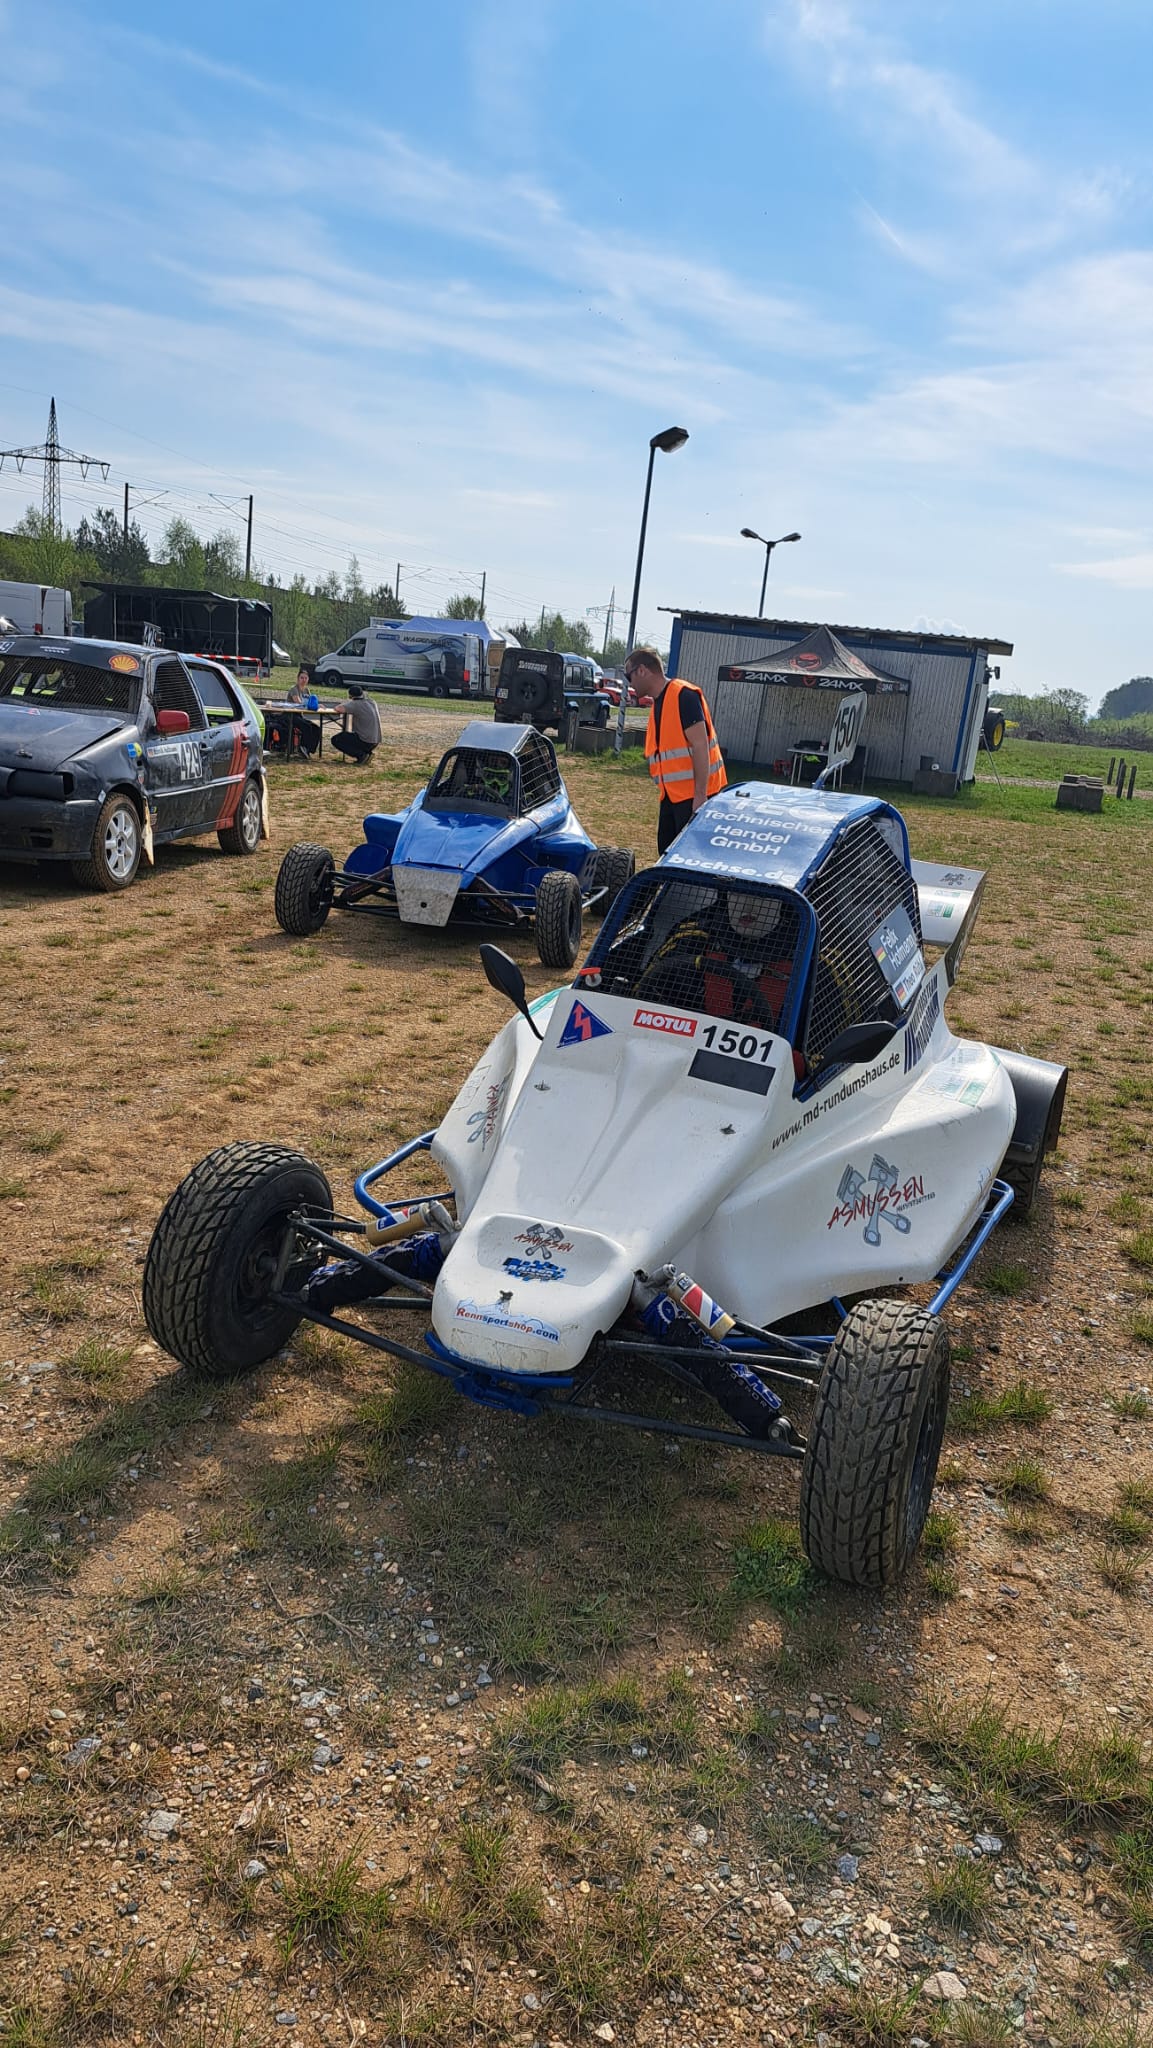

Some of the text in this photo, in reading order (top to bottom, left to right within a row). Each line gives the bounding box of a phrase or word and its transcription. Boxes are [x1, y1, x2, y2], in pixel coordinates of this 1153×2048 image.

[745, 672, 788, 684] 24MX
[819, 678, 863, 691] 24MX
[180, 743, 201, 778] 429
[704, 810, 833, 835] Technischer
[714, 824, 791, 845] Handel
[710, 836, 782, 856] GmbH
[668, 853, 800, 885] buchse.de
[880, 927, 899, 954] Felix
[887, 933, 916, 971] Hofmann
[636, 1011, 691, 1034] MOTUL
[702, 1025, 774, 1063] 1501
[771, 1052, 900, 1150] www.md-rundumshaus.de
[827, 1175, 924, 1230] ASMUSSEN
[513, 1233, 575, 1253] ASMUSSEN
[456, 1307, 559, 1341] Rennsportshop.com
